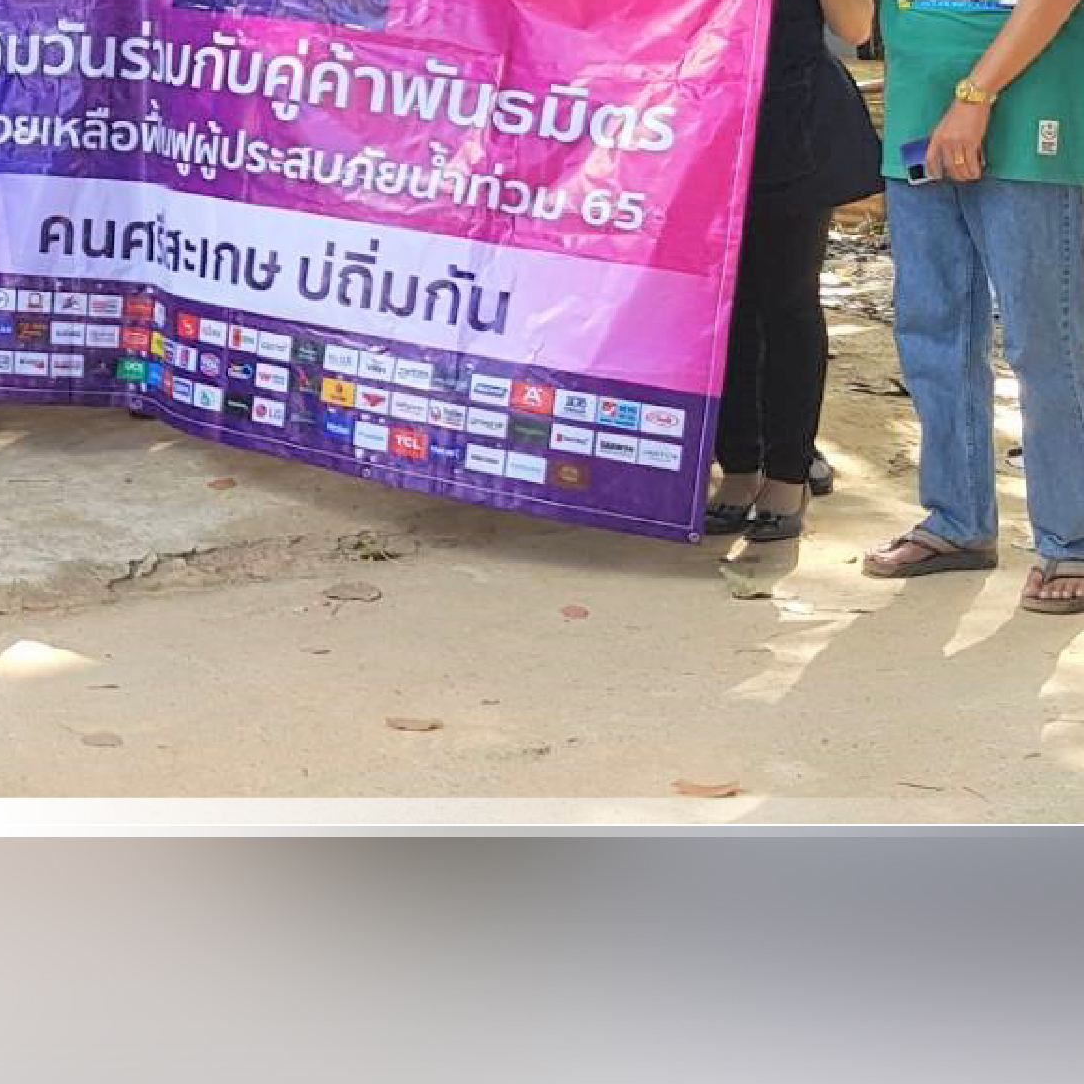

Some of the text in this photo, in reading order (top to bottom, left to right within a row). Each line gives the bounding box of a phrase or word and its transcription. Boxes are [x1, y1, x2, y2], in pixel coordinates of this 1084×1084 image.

[580, 188, 647, 232] 65
[298, 238, 511, 336] บ่ถิ่มกัน
